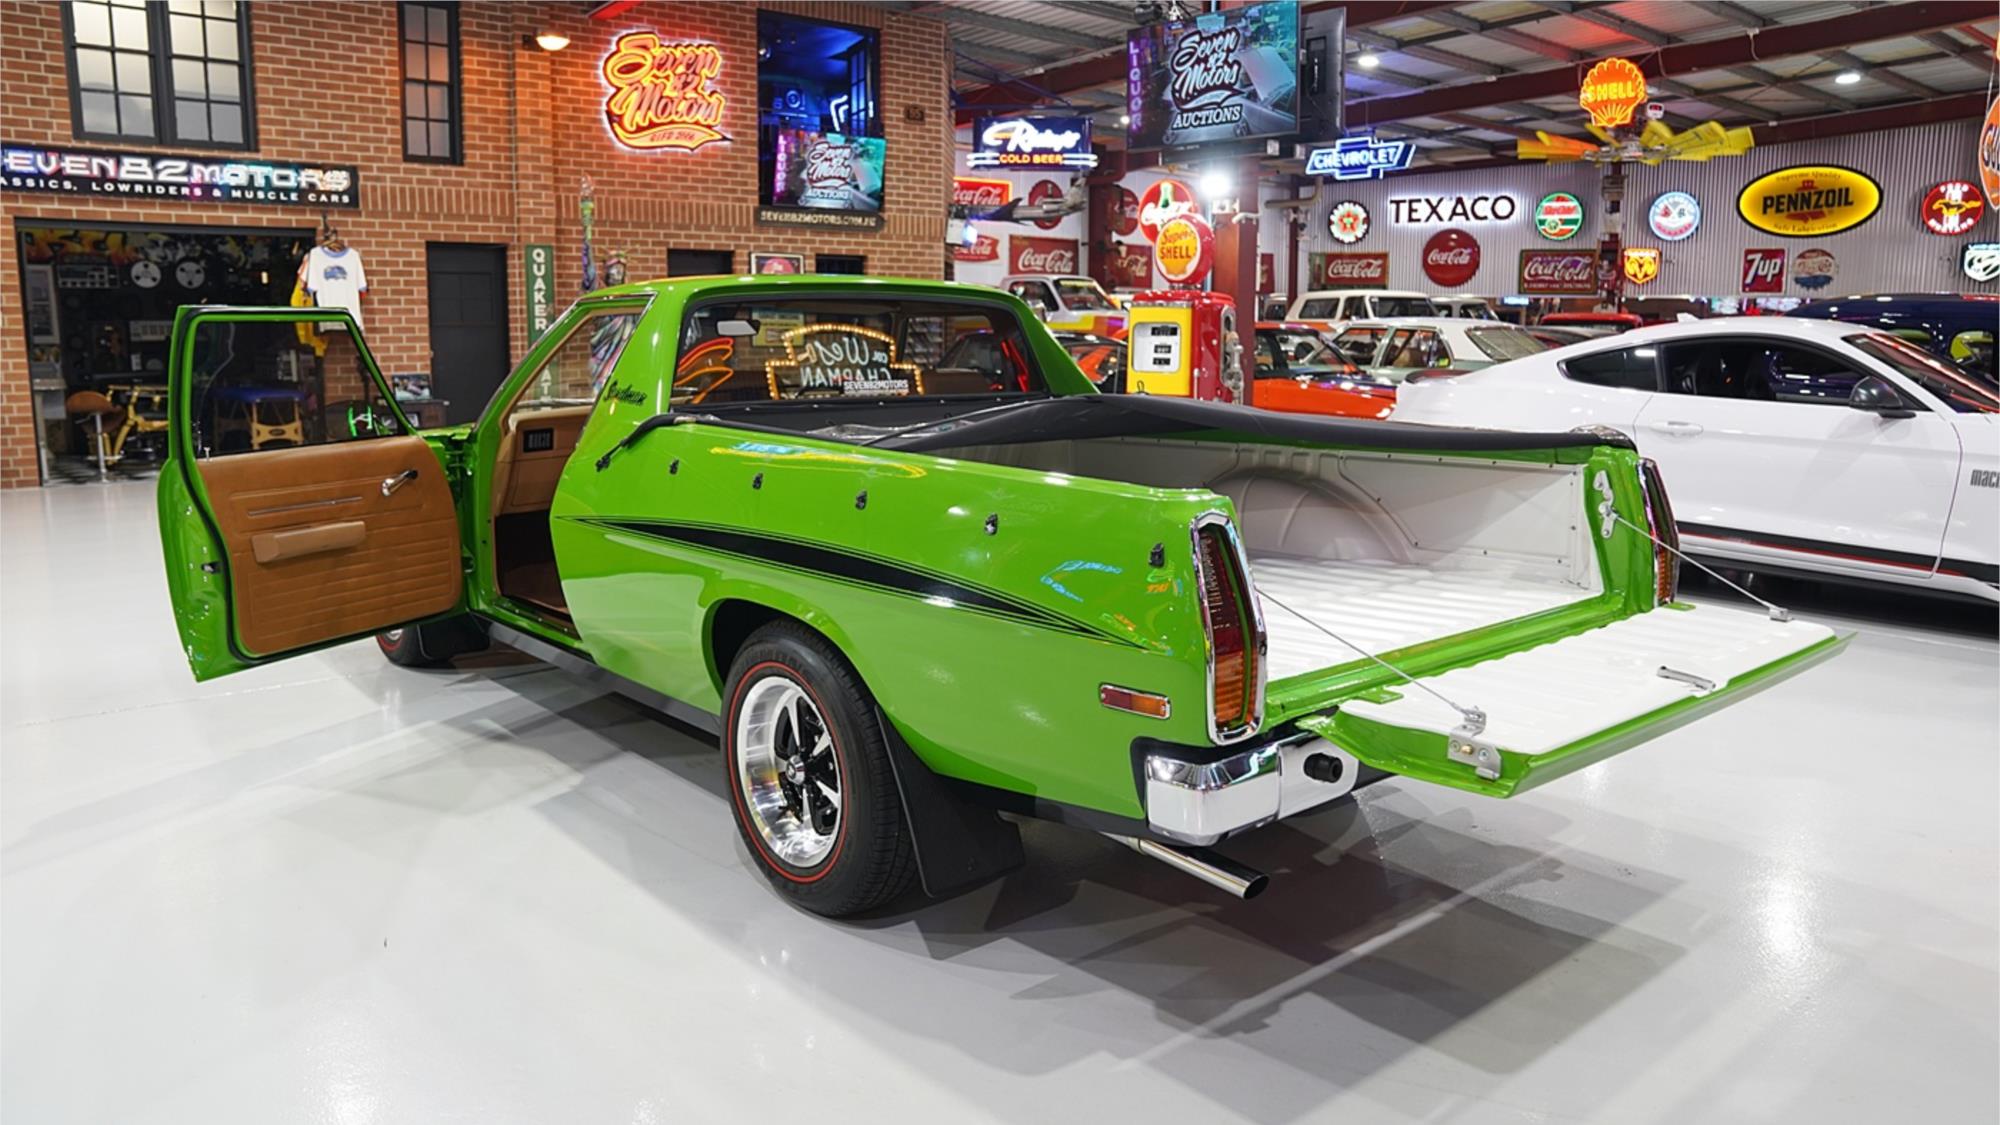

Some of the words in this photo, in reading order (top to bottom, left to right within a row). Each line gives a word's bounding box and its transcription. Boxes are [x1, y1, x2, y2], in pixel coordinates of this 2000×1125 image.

[607, 34, 721, 87] Seven
[1173, 30, 1237, 71] Seven
[1129, 41, 1142, 130] LIQUOR
[1174, 61, 1239, 98] Motors
[1587, 81, 1636, 101] SHELL
[611, 82, 725, 131] Motors
[1173, 106, 1241, 129] AUCTIONS
[3, 149, 351, 192] EVEN82MOTORS
[1000, 153, 1030, 164] COLD
[1033, 153, 1063, 165] BEER
[1314, 148, 1396, 168] CHEVROLET
[0, 177, 77, 191] ASSICS,
[92, 182, 202, 198] LOWRIDERS
[212, 188, 222, 198] &
[231, 190, 299, 201] MUSCLE
[308, 193, 350, 204] CARS
[1762, 186, 1854, 215] PENNZOIL
[1390, 195, 1516, 223] TEXACO
[1160, 245, 1192, 260] SHELL
[1745, 252, 1782, 285] 7up
[532, 248, 548, 331] QUAKER
